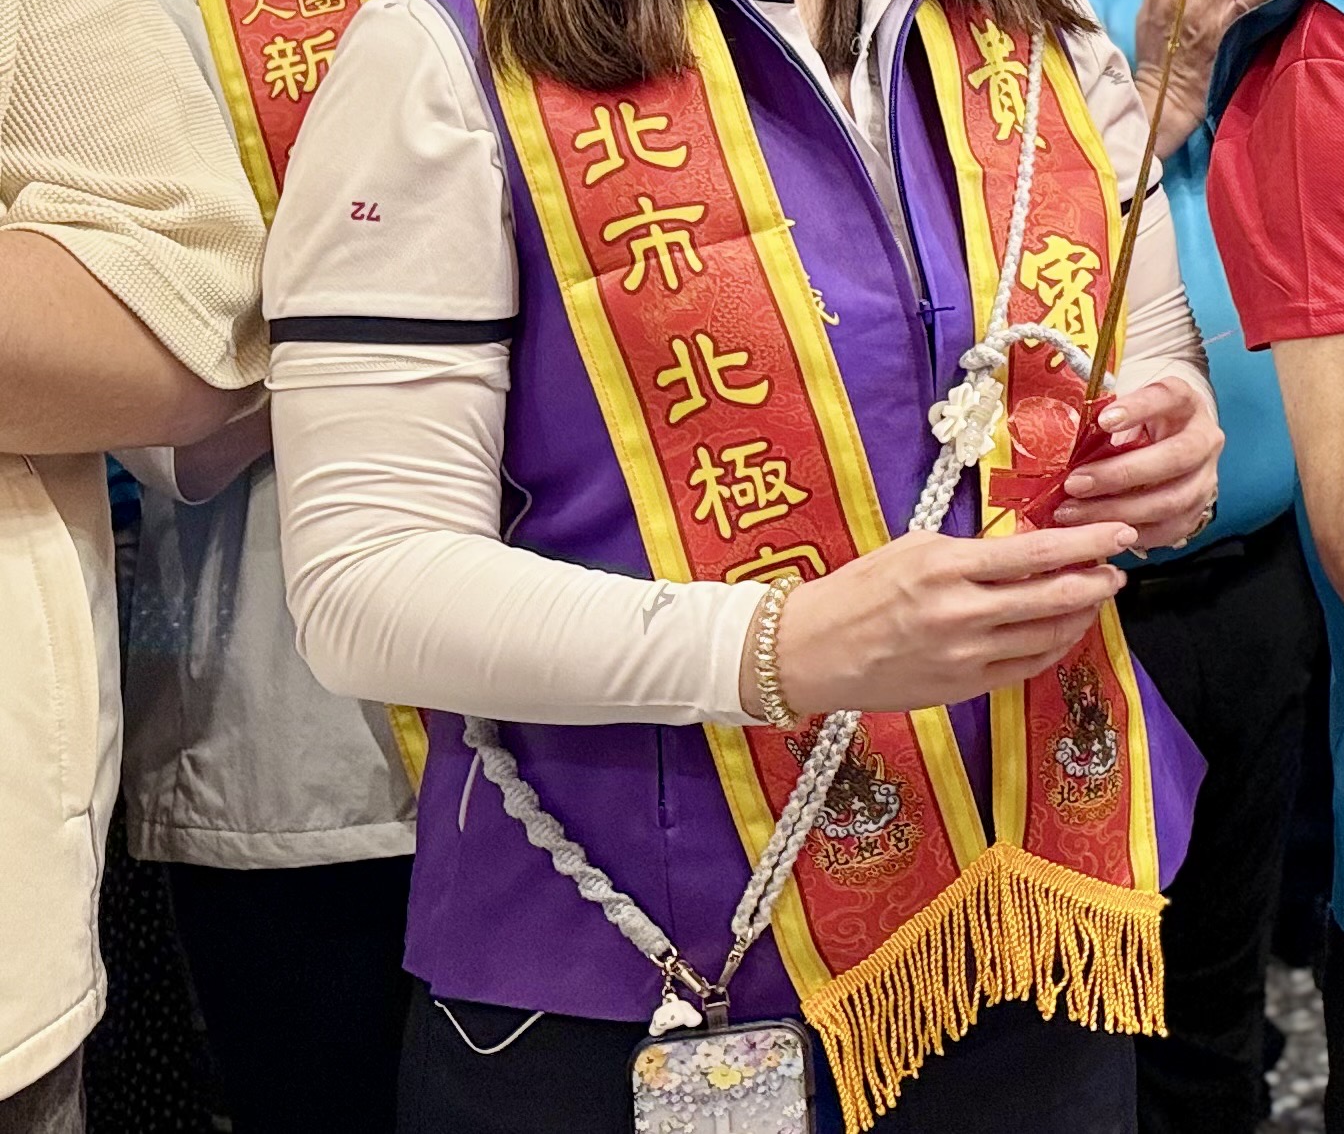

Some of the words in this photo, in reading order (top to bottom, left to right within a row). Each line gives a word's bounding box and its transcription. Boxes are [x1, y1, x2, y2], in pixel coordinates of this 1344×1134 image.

[263, 29, 336, 103] 新
[350, 201, 381, 222] 72
[820, 821, 913, 872] 北極宮
